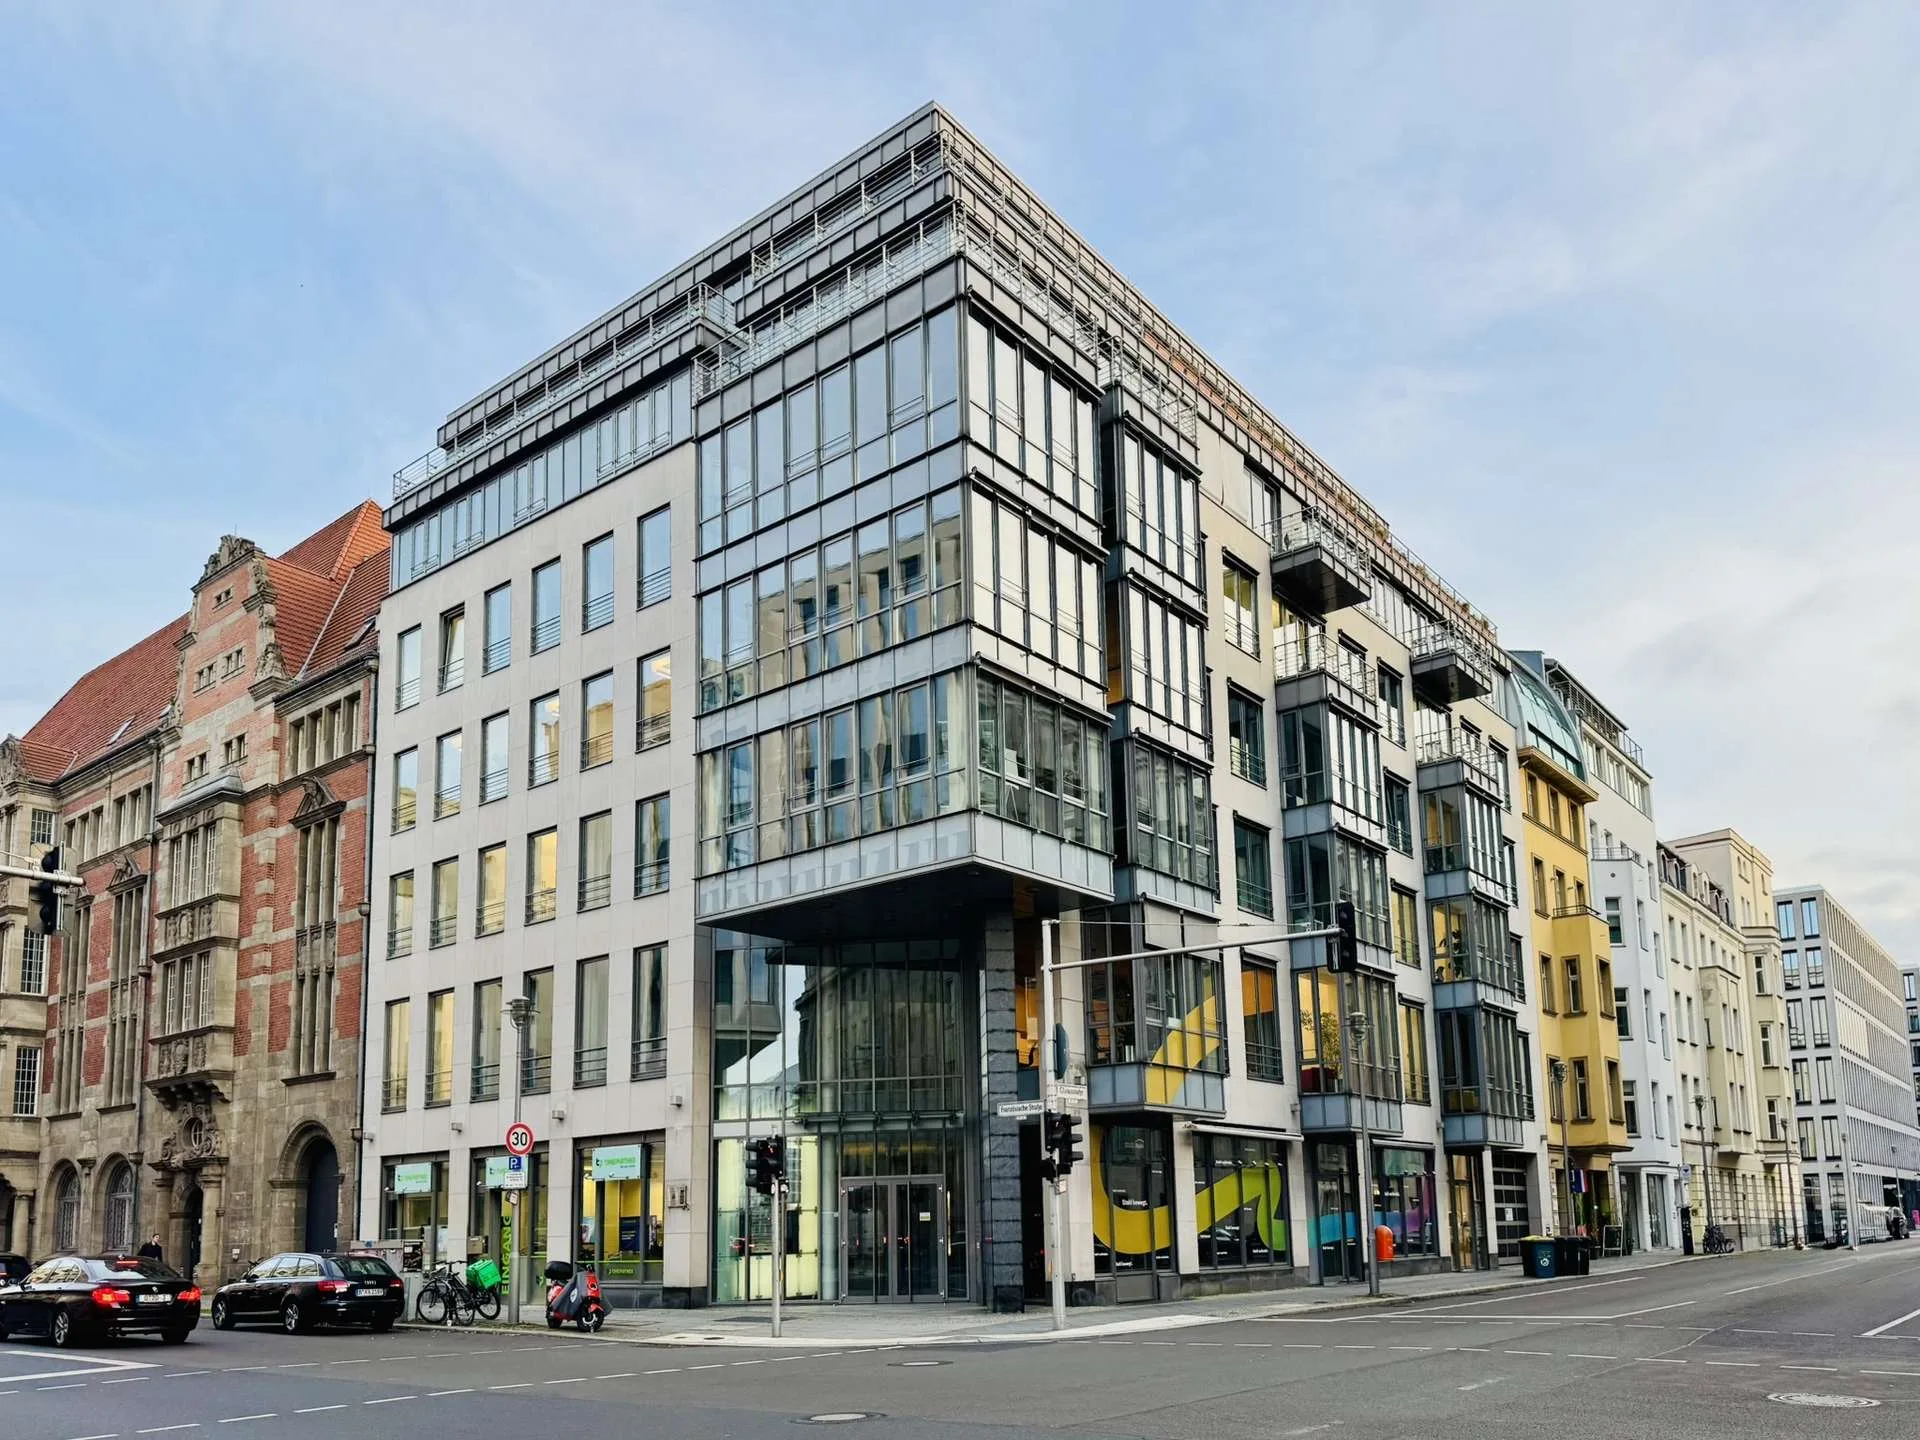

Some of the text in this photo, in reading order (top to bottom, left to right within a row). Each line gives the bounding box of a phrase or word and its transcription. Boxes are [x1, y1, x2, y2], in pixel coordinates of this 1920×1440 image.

[512, 1131, 528, 1146] 30
[510, 1157, 518, 1169] P
[501, 1215, 512, 1296] EINGANG
